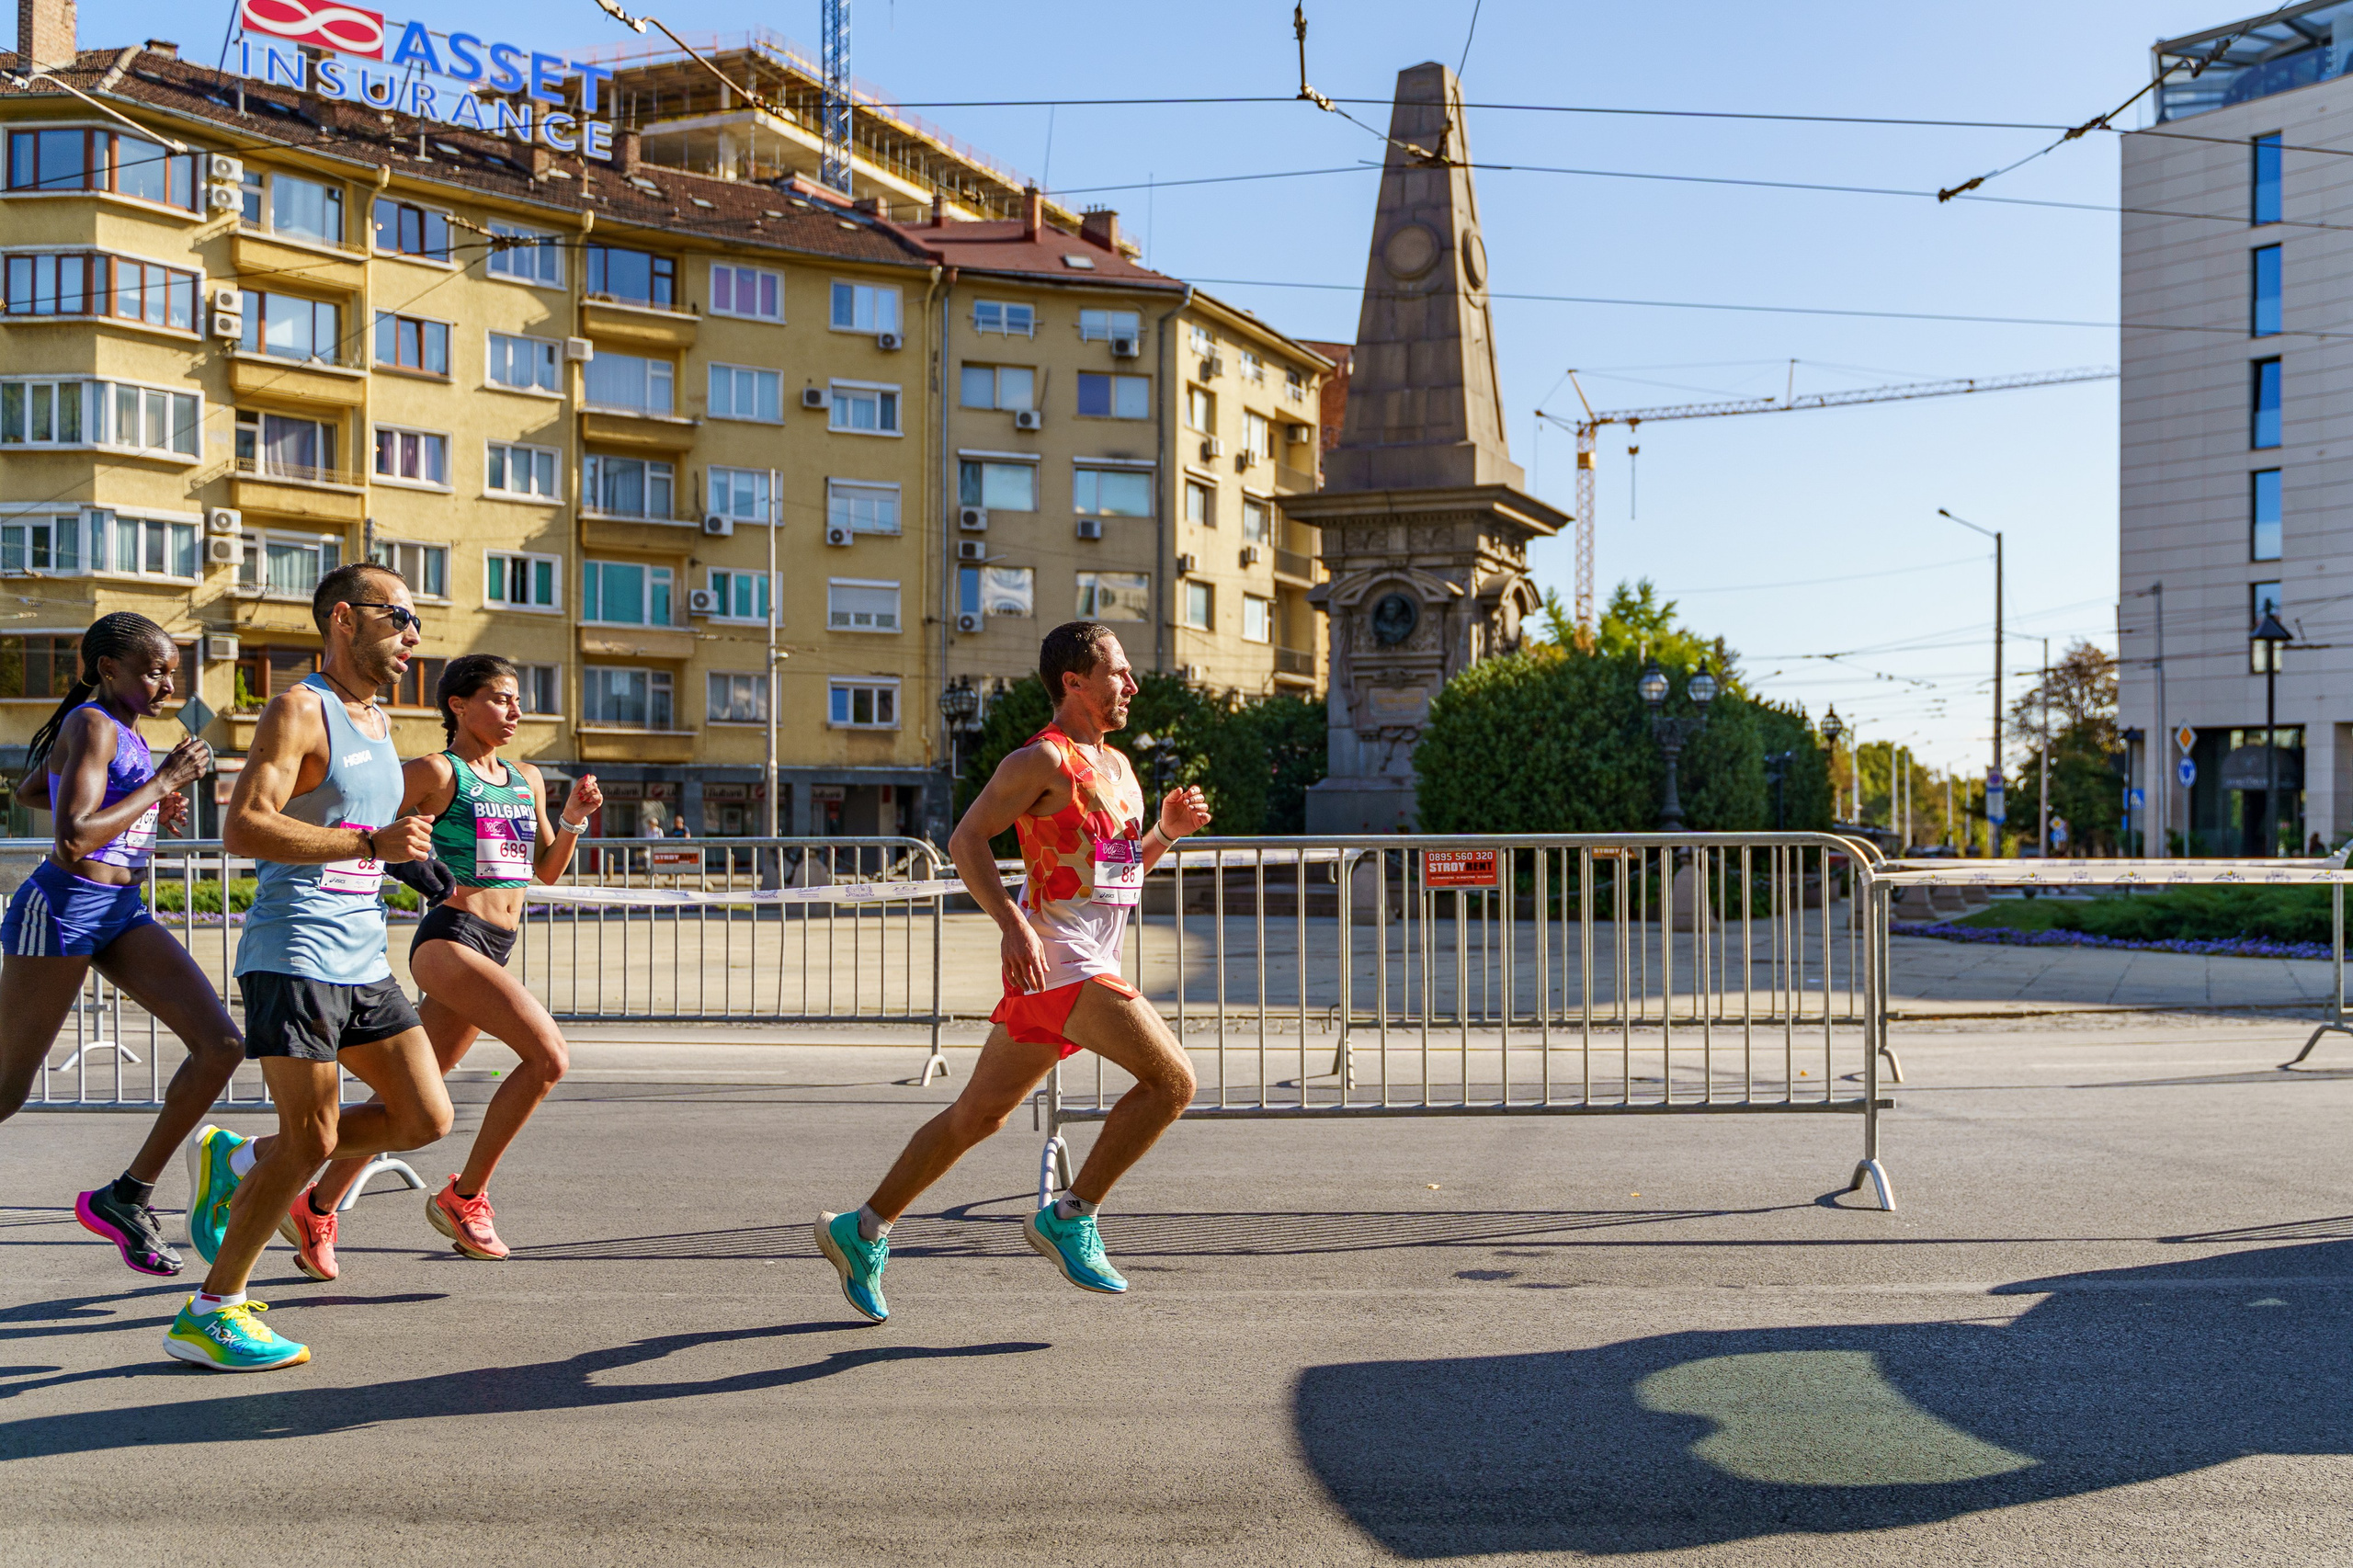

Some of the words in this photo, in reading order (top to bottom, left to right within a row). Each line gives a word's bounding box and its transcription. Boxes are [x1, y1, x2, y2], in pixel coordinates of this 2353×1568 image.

[391, 19, 614, 114] ASSET
[239, 36, 613, 162] INSURANCE
[342, 749, 373, 768] HOKA
[500, 842, 528, 858] 689
[1428, 852, 1452, 861] 0895
[1455, 852, 1473, 860] 560
[1475, 851, 1494, 860] 320
[1121, 865, 1136, 882] 86
[204, 1320, 249, 1355] HOKA
